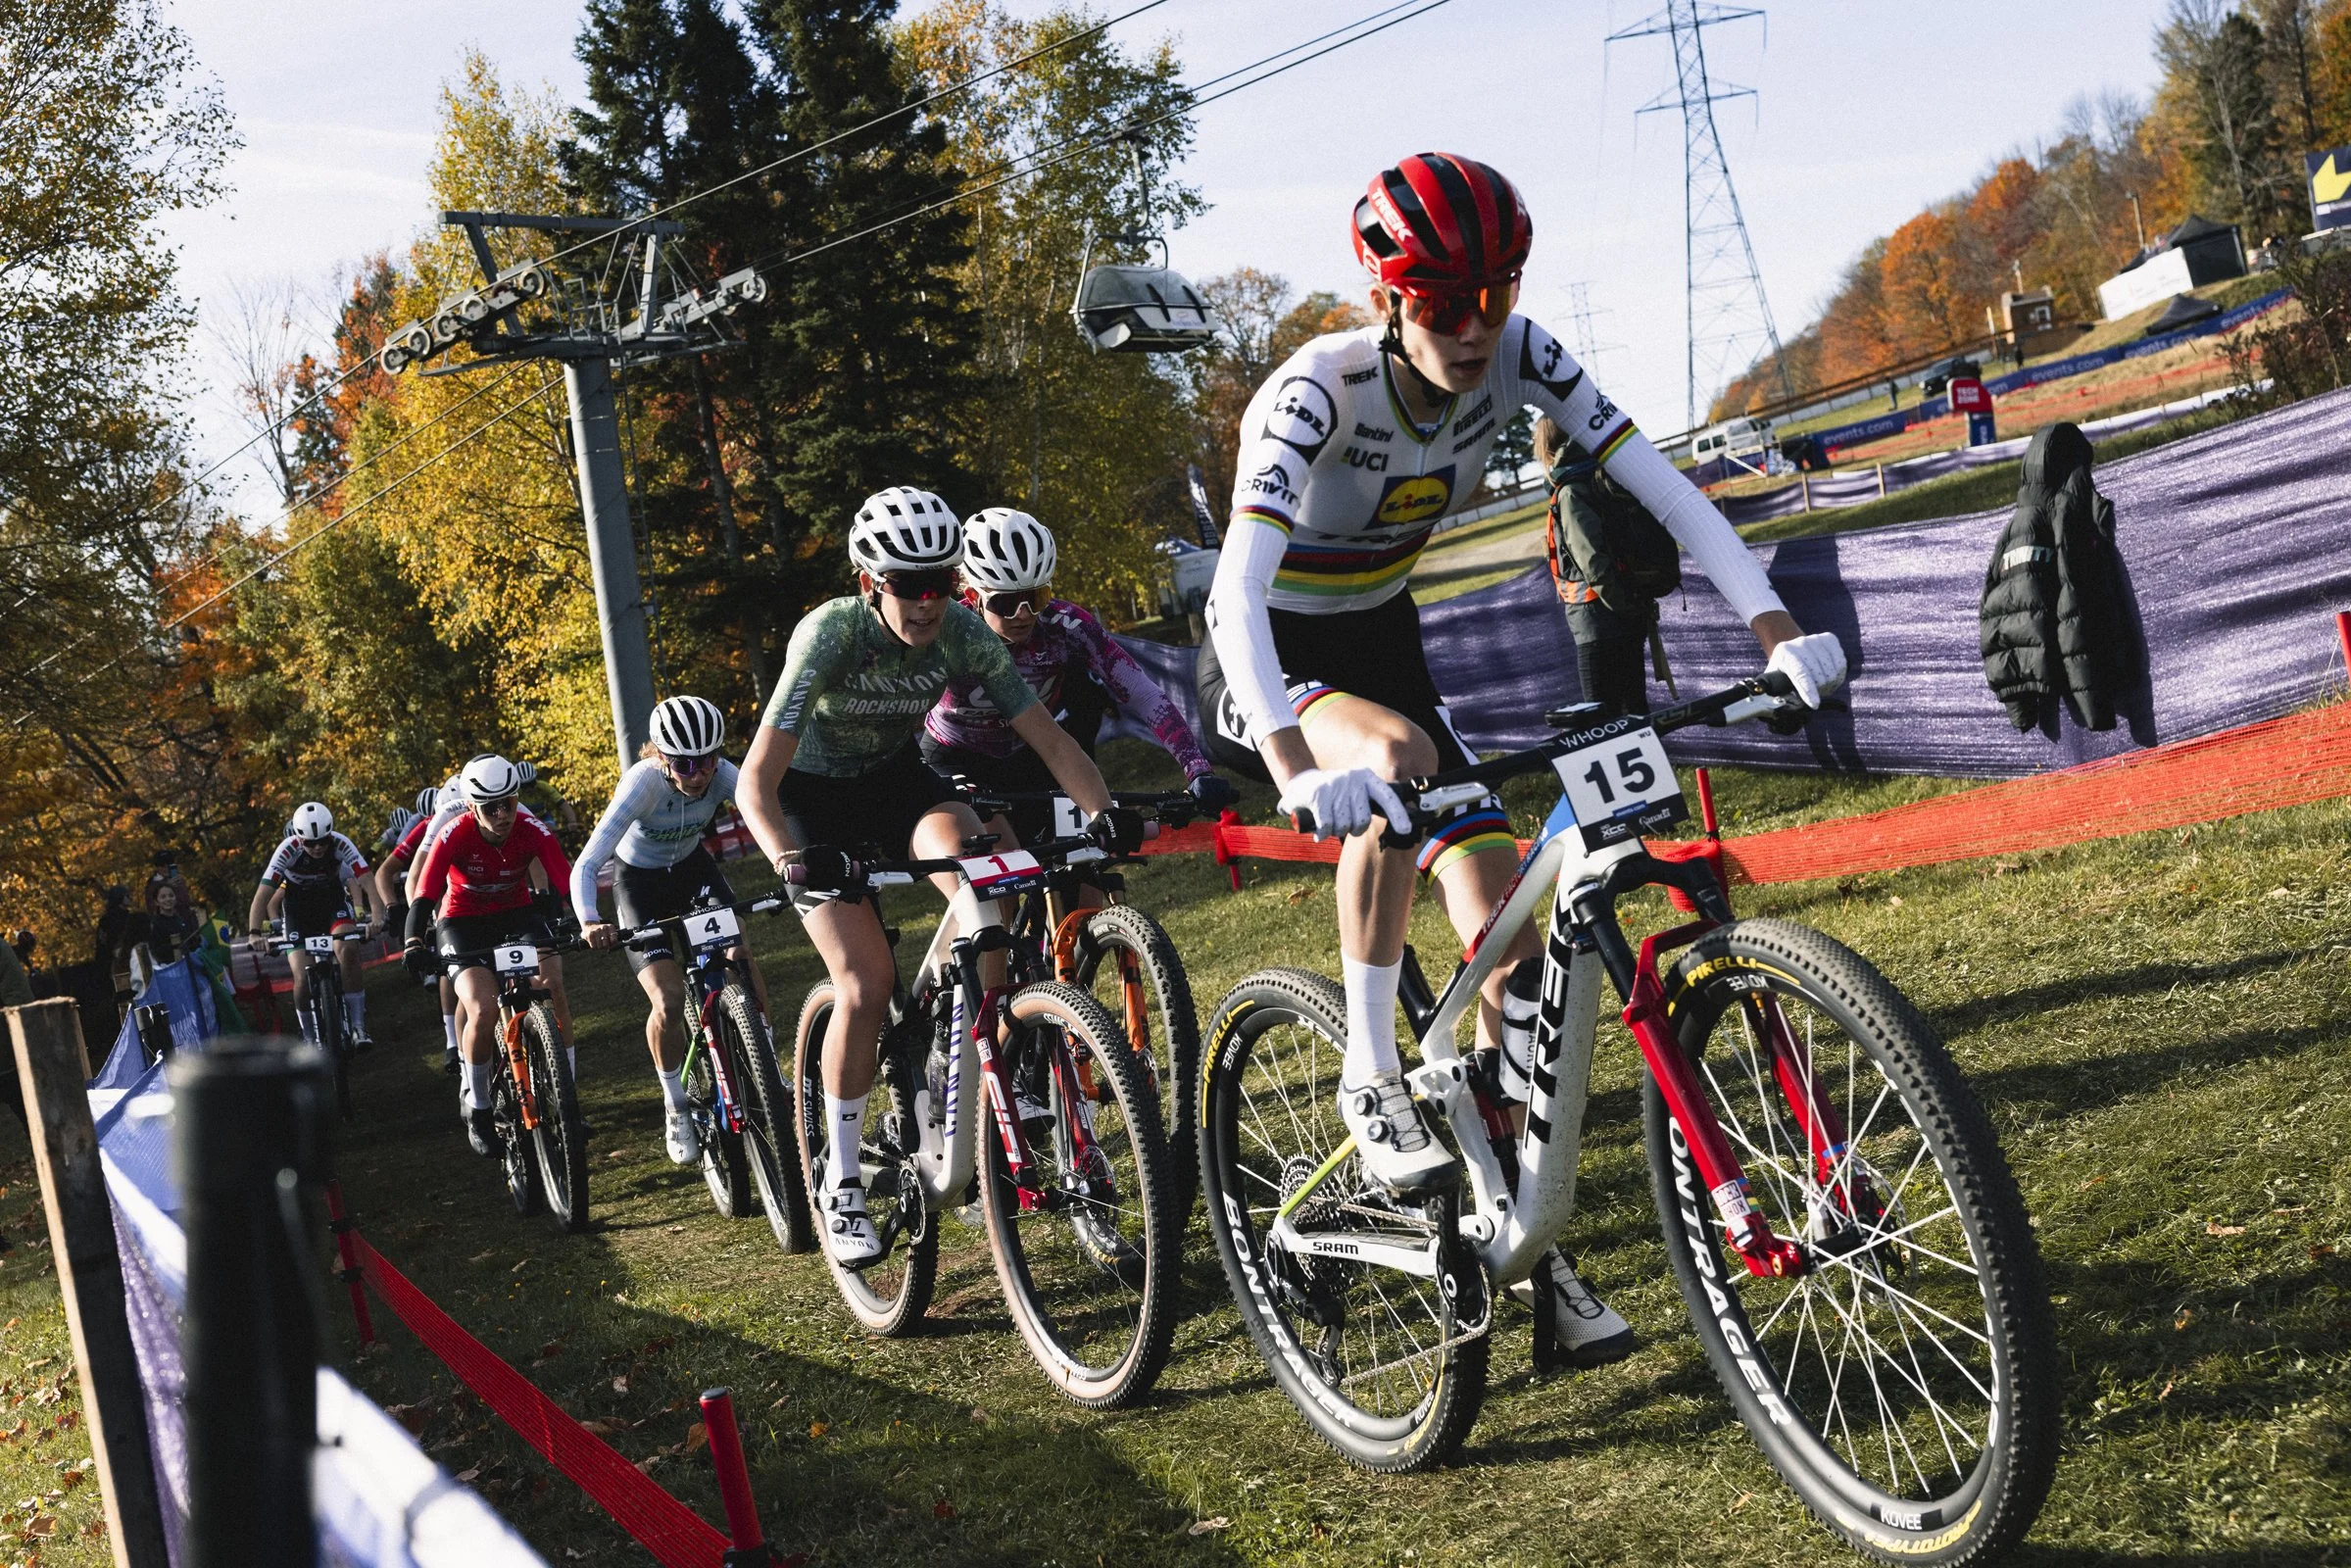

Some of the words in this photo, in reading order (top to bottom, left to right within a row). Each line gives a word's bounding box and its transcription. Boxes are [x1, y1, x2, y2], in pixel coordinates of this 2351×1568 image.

[1372, 187, 1413, 241] TREK
[1342, 367, 1379, 387] TREK
[2032, 356, 2104, 381] events.com
[1452, 418, 1496, 455] SRAM
[1824, 418, 1894, 446] events.com
[1349, 448, 1390, 472] UCI
[844, 666, 949, 695] CANYON
[779, 669, 816, 730] CANYON
[843, 698, 930, 715] ROCKSHOX
[1559, 718, 1629, 750] WHOOP
[1584, 747, 1655, 805] 15
[1103, 812, 1117, 839] ERGON
[1639, 808, 1671, 826] Canada
[988, 855, 1010, 873] 1
[1013, 879, 1037, 891] Canada
[704, 917, 721, 935] 4
[310, 939, 328, 948] 13
[509, 951, 523, 964] 9
[1686, 956, 1757, 988] PIRELLI
[1726, 974, 1770, 992] KOVEE
[1524, 886, 1574, 1151] TREK
[1203, 1011, 1234, 1084] PIRELLI
[1222, 1033, 1244, 1071] KOVEE
[804, 1078, 812, 1098] DT
[804, 1100, 815, 1138] SWISS
[834, 1237, 875, 1251] ANYON
[1312, 1241, 1359, 1255] SRAM
[1669, 1116, 1792, 1426] ONTRAGER
[1223, 1191, 1360, 1428] BONTRAGER
[1880, 1507, 1923, 1531] KOVEE
